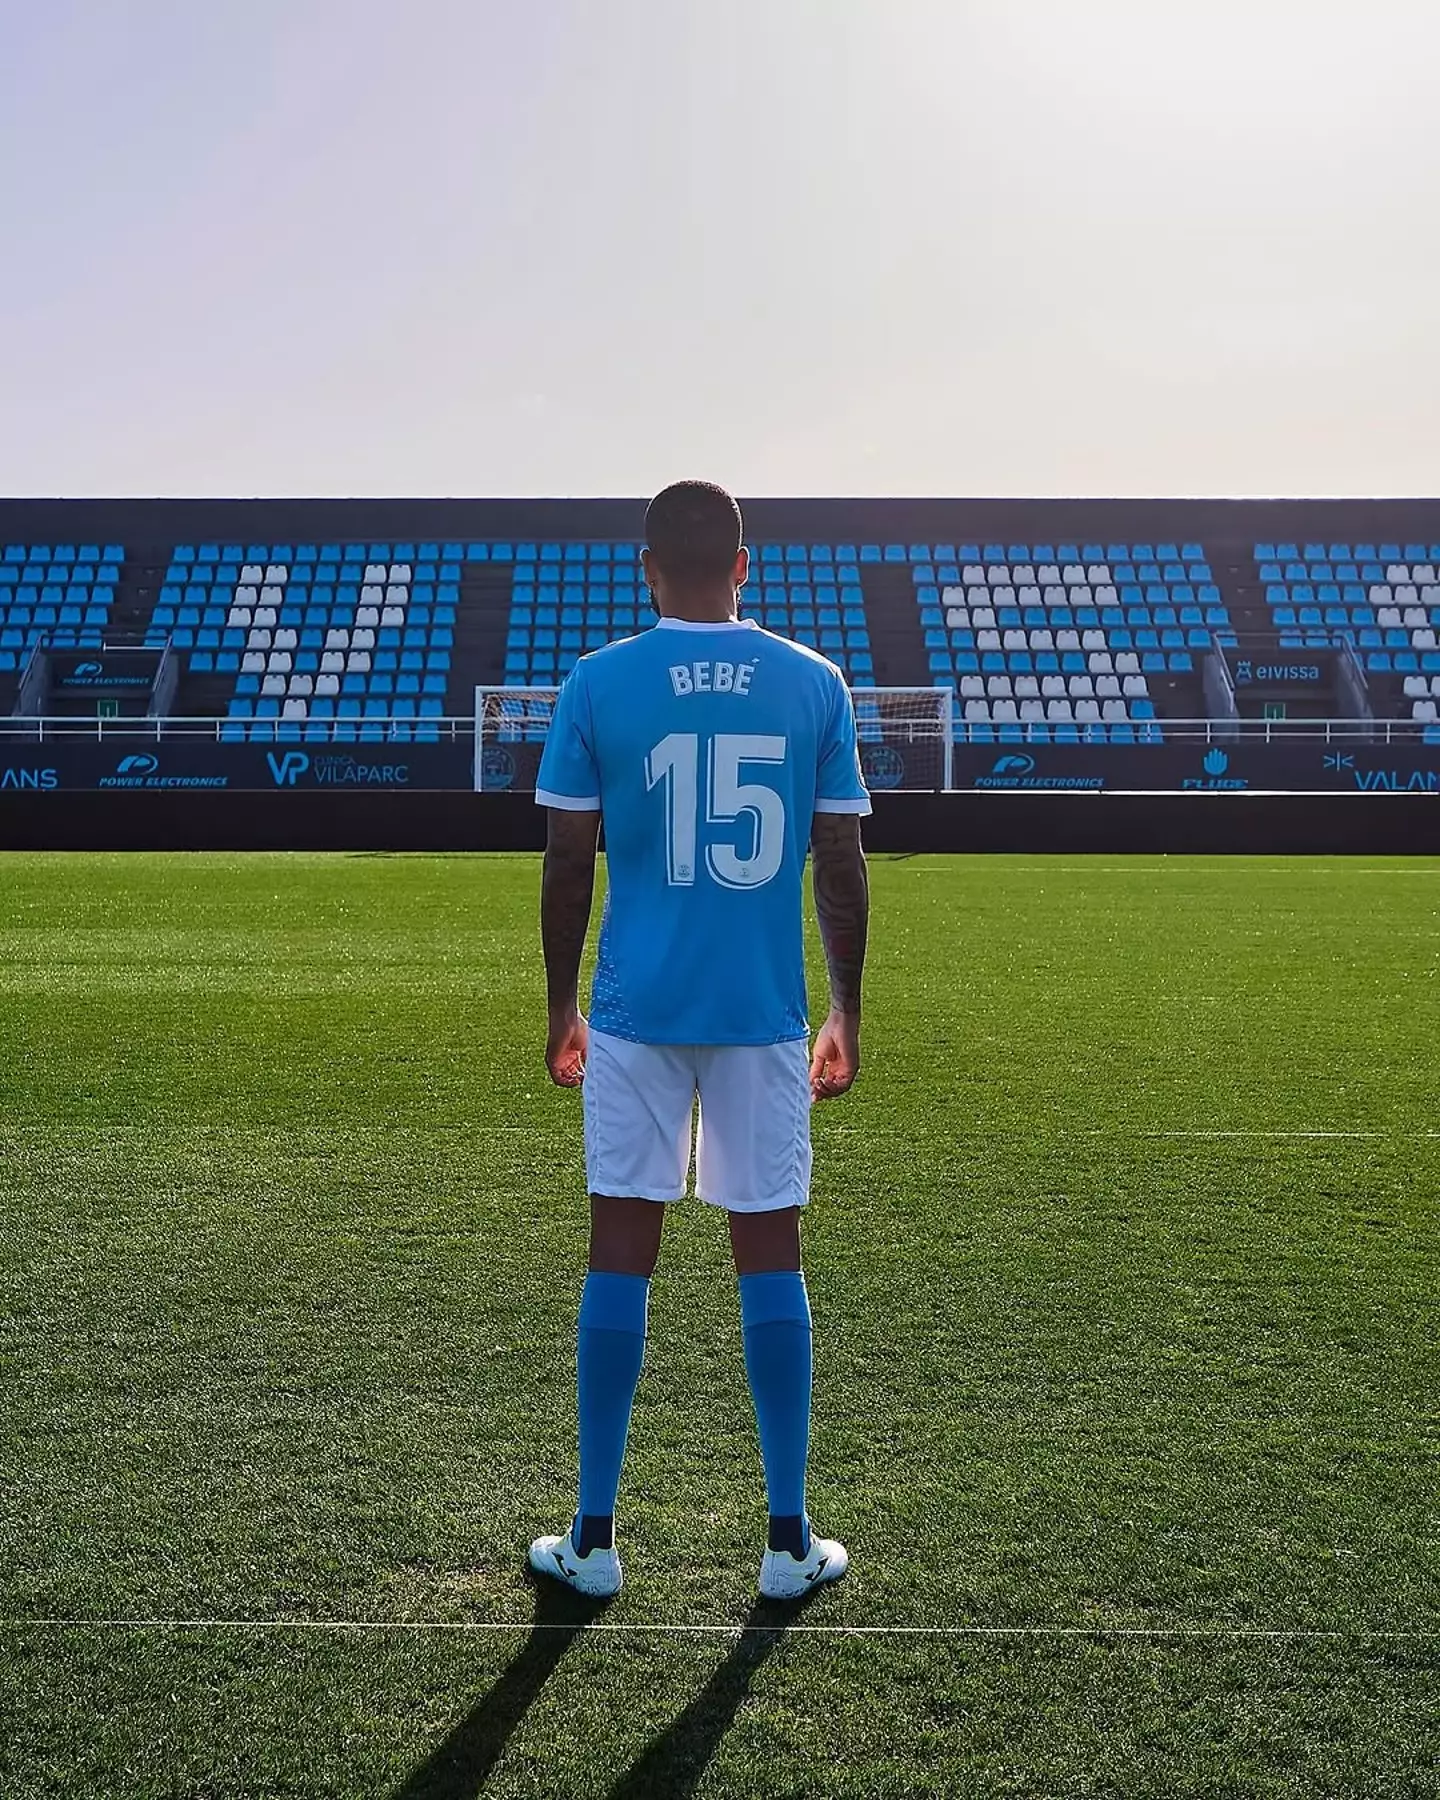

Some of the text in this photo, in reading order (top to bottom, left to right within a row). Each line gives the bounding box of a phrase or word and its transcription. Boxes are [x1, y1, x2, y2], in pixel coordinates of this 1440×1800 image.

[668, 656, 760, 697] BEBÉ
[1256, 664, 1319, 680] eivissa
[266, 751, 309, 786] VP
[314, 765, 409, 783] VILAPARC
[99, 776, 228, 787] POWER ELECTRONICS
[974, 777, 1105, 788] POWER ELECTRONICS
[643, 732, 787, 891] 15
